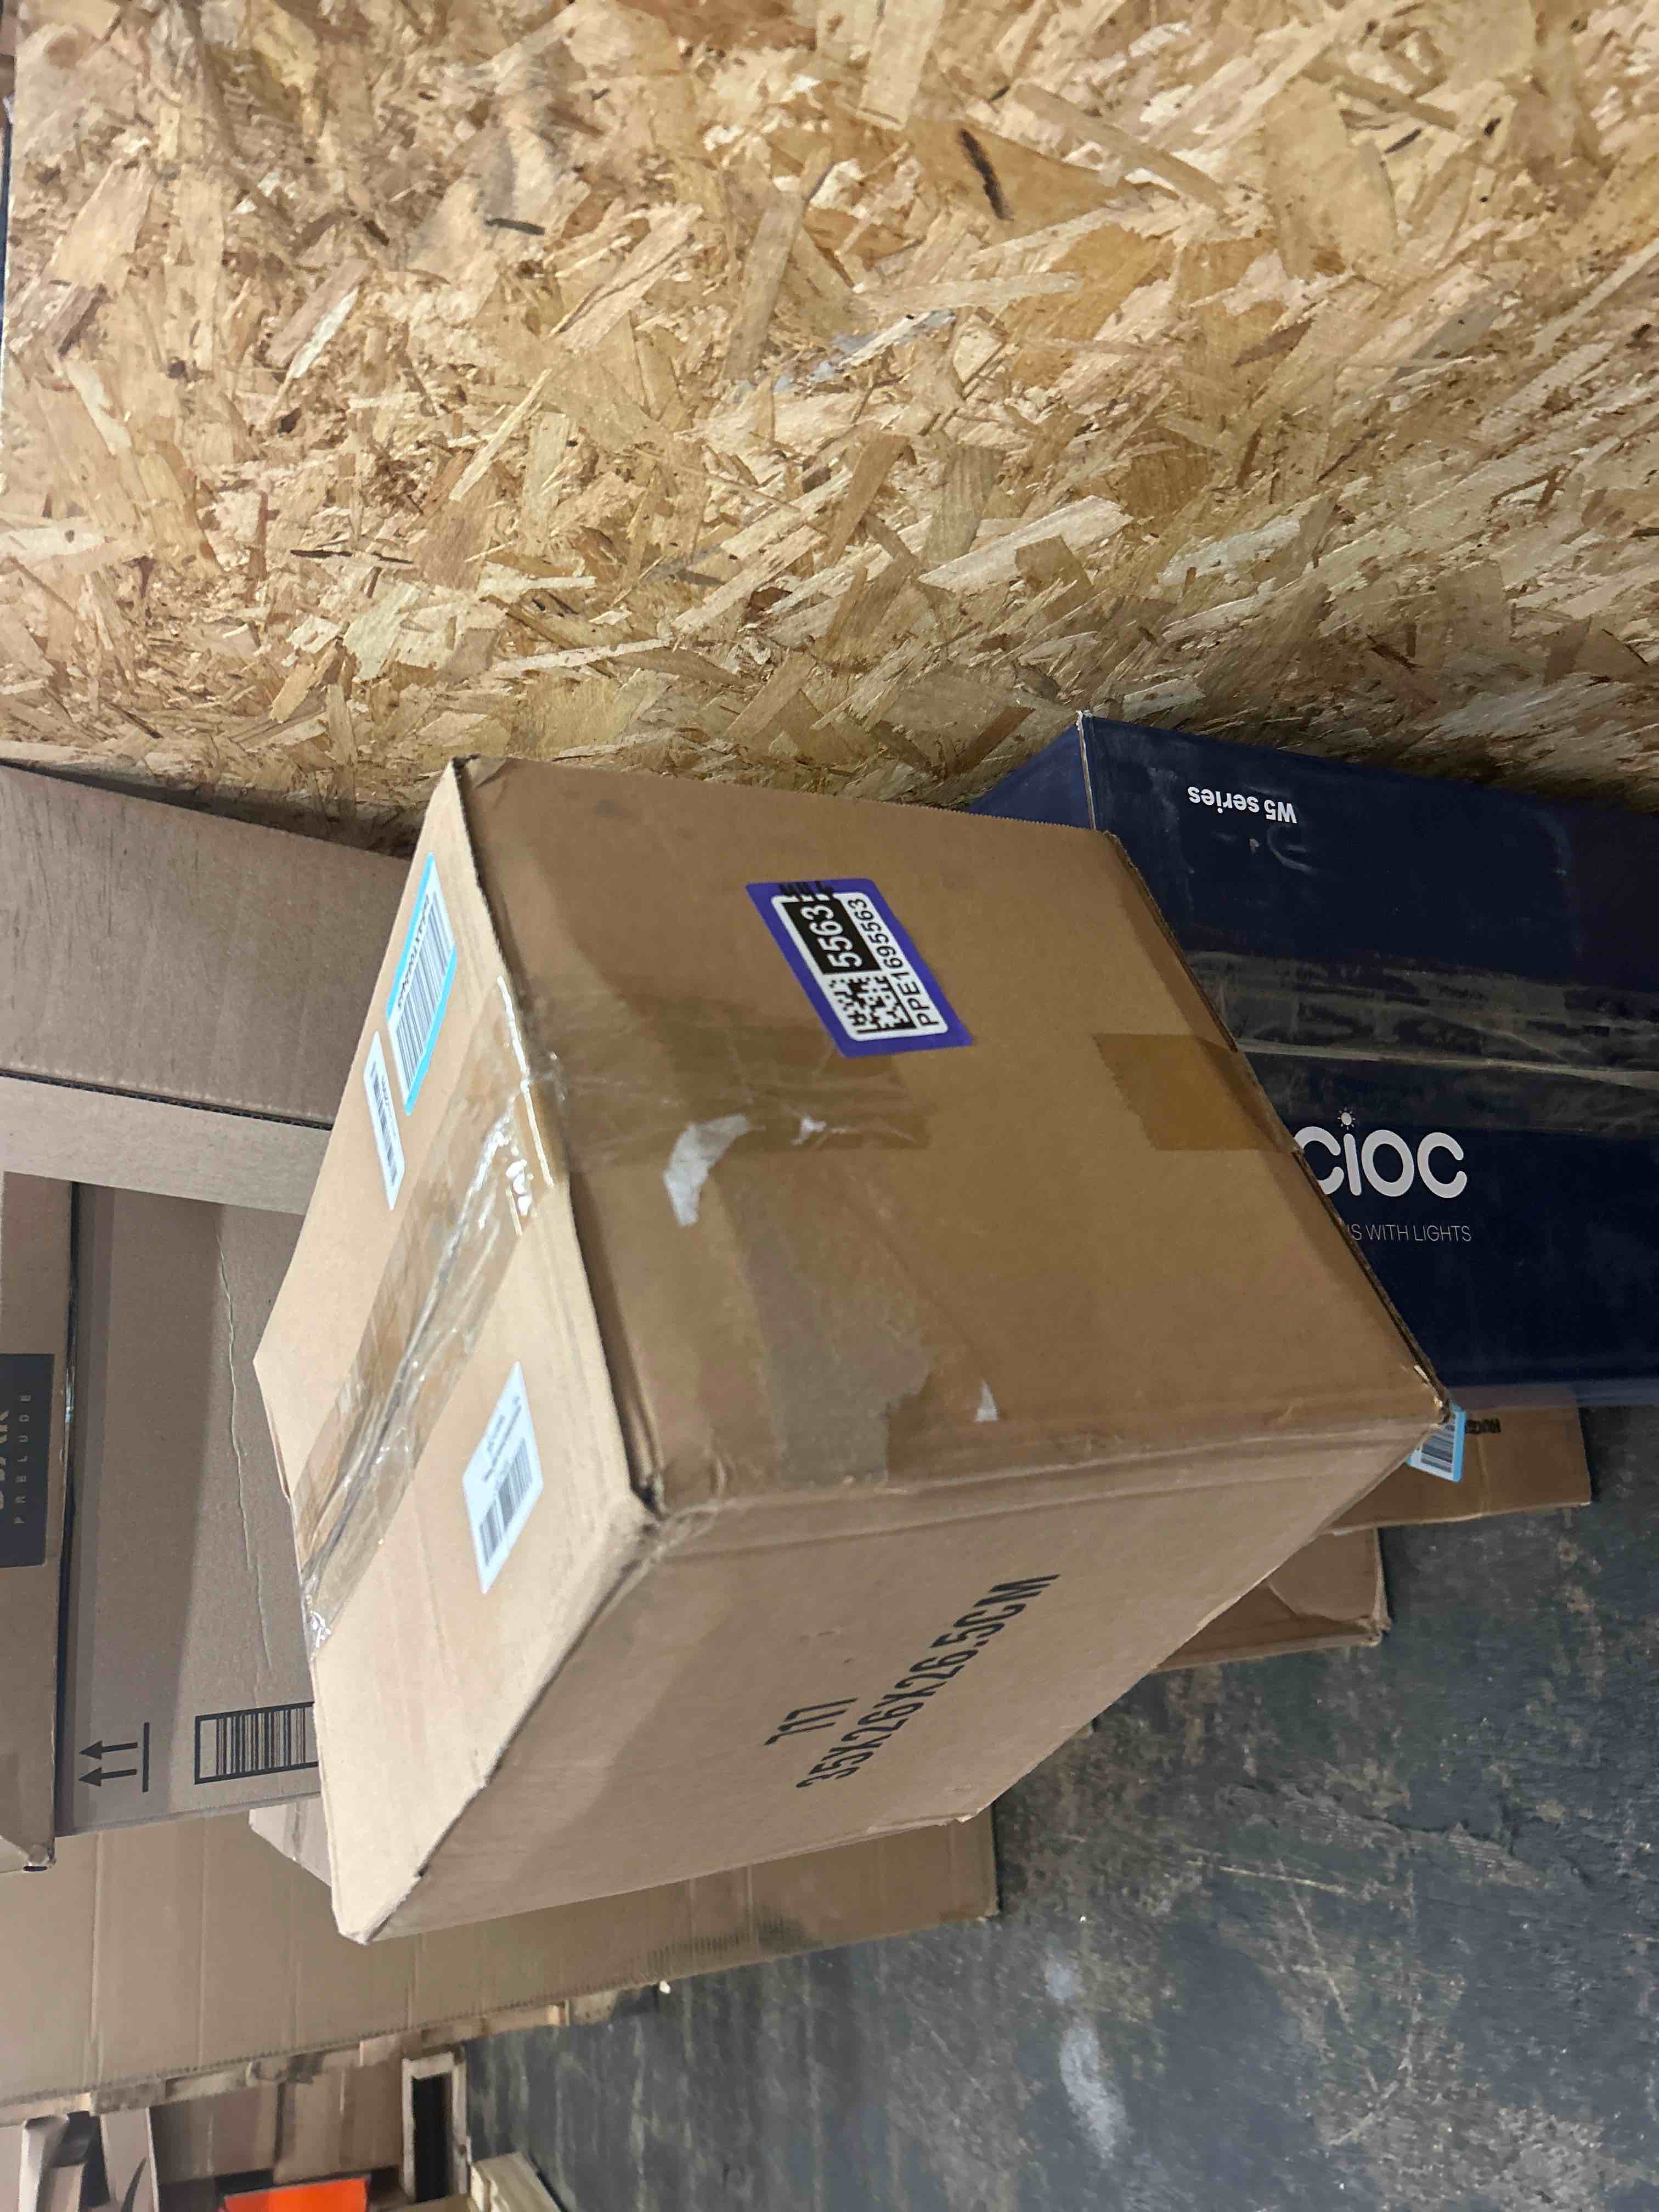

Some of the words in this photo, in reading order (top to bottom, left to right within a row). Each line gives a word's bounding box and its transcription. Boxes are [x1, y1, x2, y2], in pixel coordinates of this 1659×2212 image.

[1187, 787, 1260, 813] series
[1265, 799, 1297, 823] W5
[800, 905, 863, 968] 5563
[849, 899, 939, 1026] PPE1695563
[1365, 1224, 1409, 1241] WITH
[1414, 1226, 1471, 1242] LIGHTS
[14, 1395, 31, 1523] PRELUDE
[797, 1574, 1060, 1788] 35X26X26.5CM
